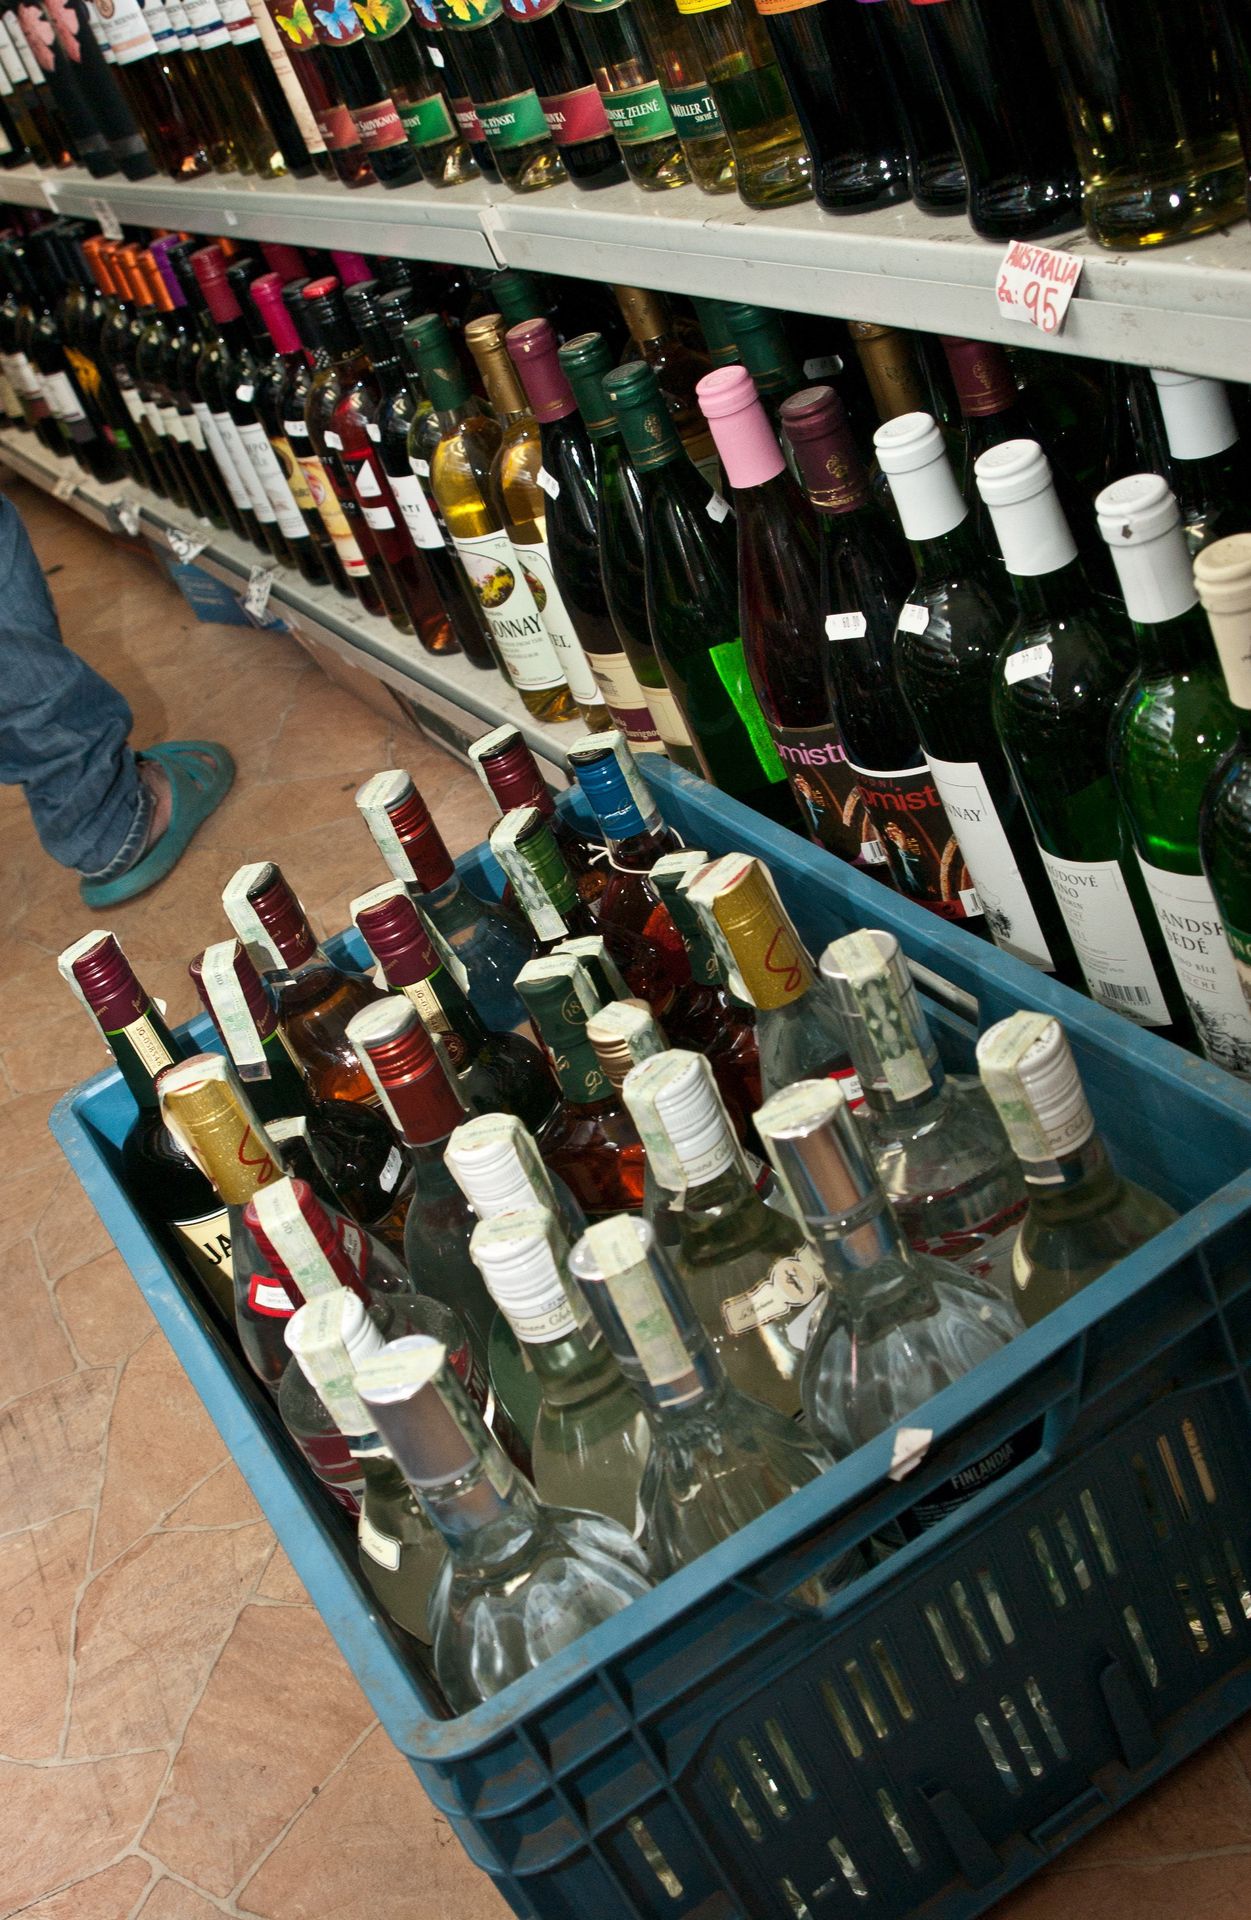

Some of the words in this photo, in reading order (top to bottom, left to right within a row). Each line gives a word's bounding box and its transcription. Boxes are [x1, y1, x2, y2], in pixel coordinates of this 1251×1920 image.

[670, 102, 703, 118] MÜLLER
[1023, 281, 1059, 333] 95
[951, 1441, 1015, 1490] FINLANDIA
